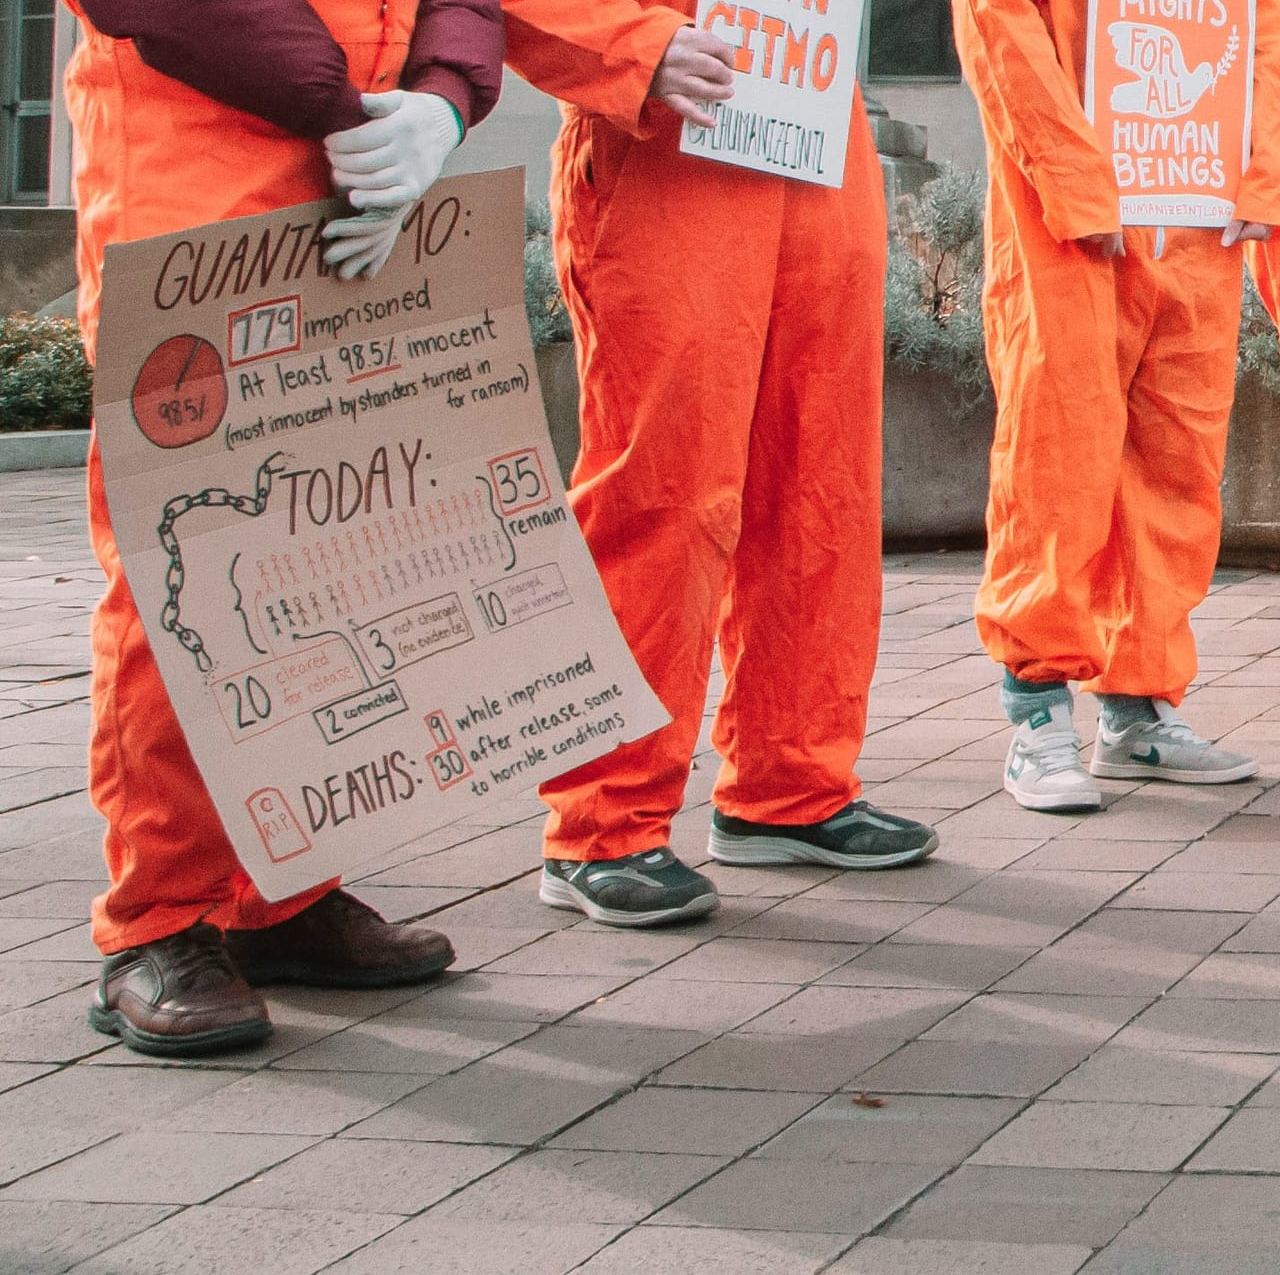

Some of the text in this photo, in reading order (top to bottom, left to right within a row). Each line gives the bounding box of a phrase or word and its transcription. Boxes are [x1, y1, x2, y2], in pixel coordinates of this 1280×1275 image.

[1129, 27, 1178, 77] FOR
[1145, 78, 1192, 114] ALL
[1112, 119, 1220, 157] HUMAN
[1112, 152, 1226, 189] BEINGS
[233, 277, 431, 355] 779 imprisoned
[238, 307, 497, 401] At least 98.5% innocent
[225, 416, 265, 451] (most
[268, 396, 333, 435] innocent
[421, 361, 473, 390] turned
[477, 358, 491, 374] in
[446, 362, 530, 409] for ransom)
[278, 438, 437, 536] TODAY:
[496, 456, 541, 503] 35
[508, 506, 567, 537] remain
[476, 591, 507, 627] 10
[369, 629, 396, 670] 3
[224, 675, 272, 729] 20
[326, 687, 399, 735] 2 convicted
[430, 652, 596, 742] 9 while imprisoned
[433, 749, 465, 783] 30
[470, 734, 512, 763] after
[584, 682, 623, 710] some
[470, 711, 626, 797] to horrible conditions
[301, 749, 423, 834] DEATHS:
